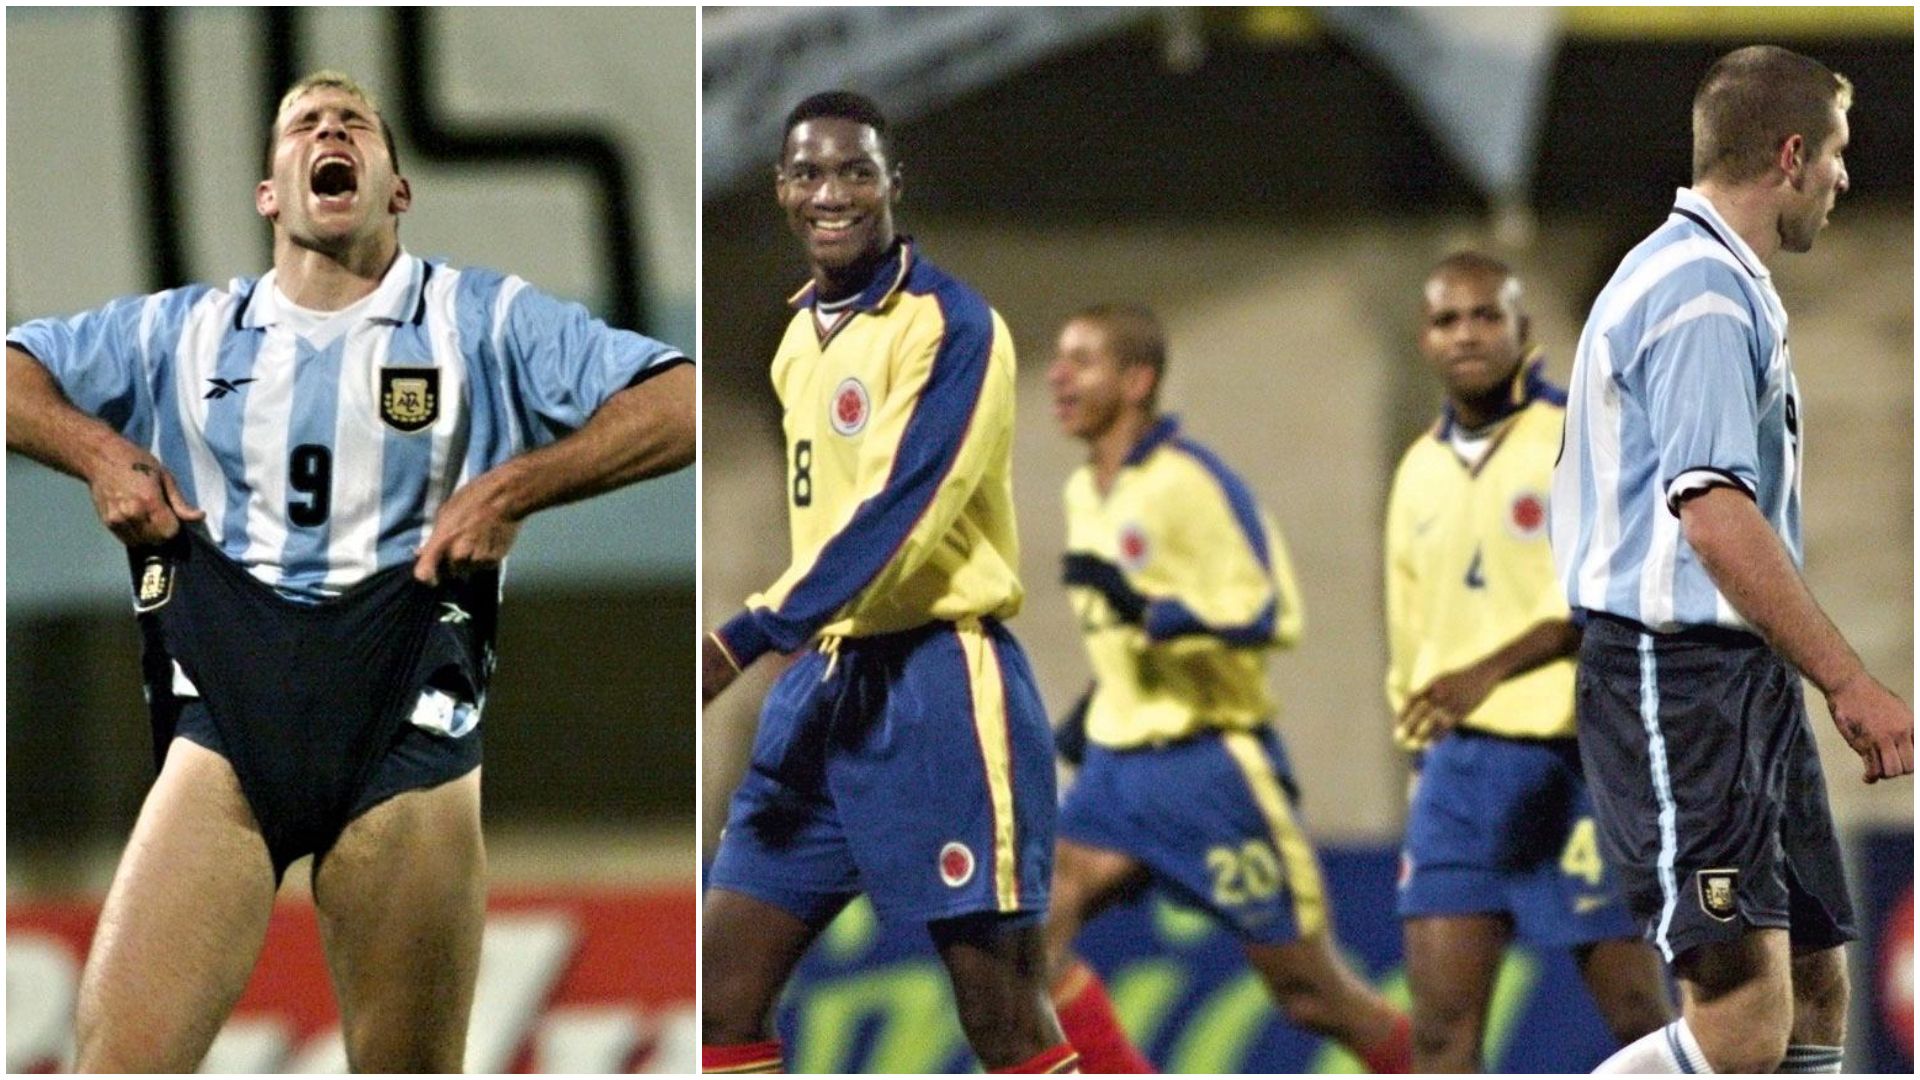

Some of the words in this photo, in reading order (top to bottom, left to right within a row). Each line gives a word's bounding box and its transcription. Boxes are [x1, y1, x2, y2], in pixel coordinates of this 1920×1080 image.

[288, 443, 332, 528] 9
[794, 440, 811, 507] 8
[1206, 840, 1281, 906] 20
[1560, 816, 1602, 885] 4
